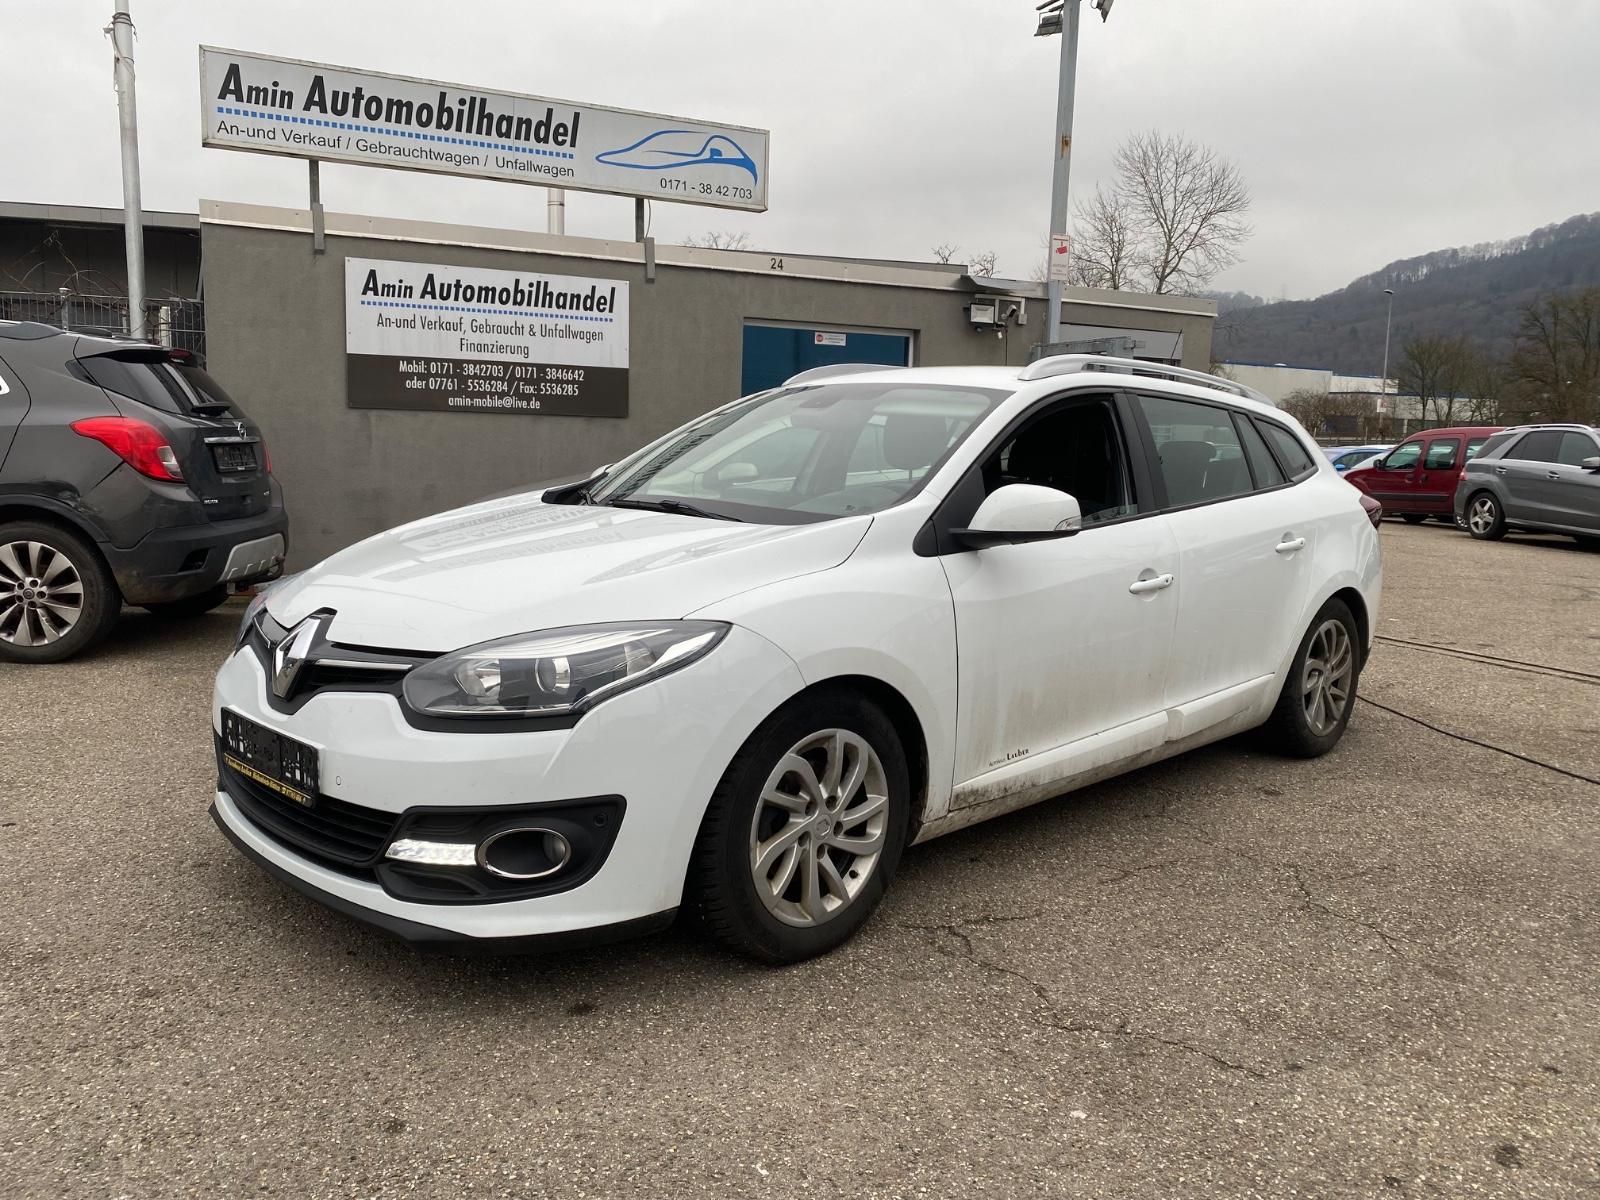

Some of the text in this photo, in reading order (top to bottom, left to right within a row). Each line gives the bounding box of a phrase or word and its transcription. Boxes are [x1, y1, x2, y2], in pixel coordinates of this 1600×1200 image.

[217, 63, 580, 148] Amin Automobilhandel
[217, 120, 574, 178] An-und Verkauf / Gebrauchtwagen / Unfallwagen
[660, 178, 686, 192] 0171
[699, 183, 712, 194] 38
[716, 185, 728, 196] 42
[733, 187, 752, 199] 703
[770, 258, 783, 270] 24
[361, 269, 615, 313] Amin Automobilhandel
[377, 313, 603, 343] An-und Verkauf, Gebraucht & Unfallwagen
[460, 338, 529, 358] Finanzierung
[400, 361, 427, 374] Mobil:
[430, 363, 453, 374] 0171
[463, 364, 503, 377] 3842703
[506, 365, 513, 379] /
[516, 367, 536, 378] 0171
[546, 368, 584, 380] 3846642
[405, 377, 426, 389] oder
[429, 379, 457, 390] 07761
[468, 380, 507, 392] 5536284
[510, 381, 517, 395] /
[520, 382, 537, 393] Fax:
[540, 383, 578, 395] 5536285
[449, 396, 540, 409] amin-mobile@live.de
